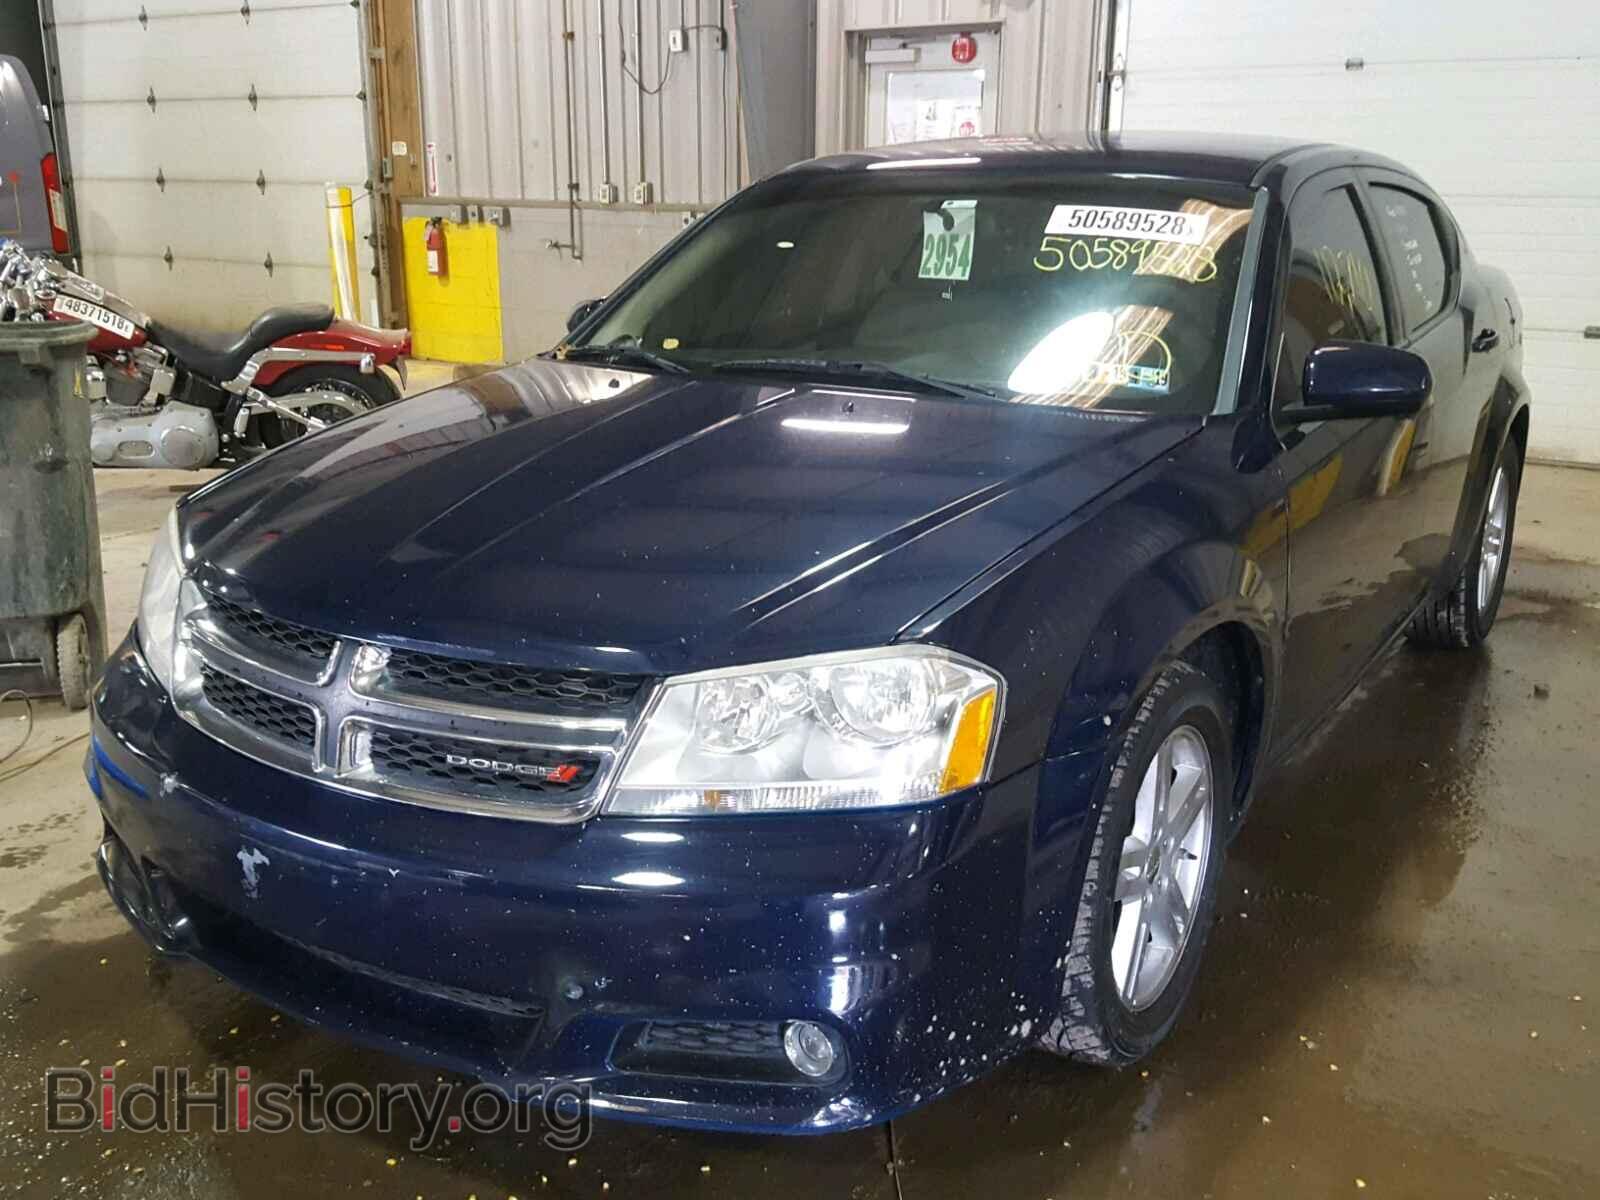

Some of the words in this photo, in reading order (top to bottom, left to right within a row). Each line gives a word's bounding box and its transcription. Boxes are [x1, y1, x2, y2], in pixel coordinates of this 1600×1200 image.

[1068, 208, 1187, 236] 50589528
[921, 233, 970, 277] 2954
[446, 754, 561, 778] DODGE
